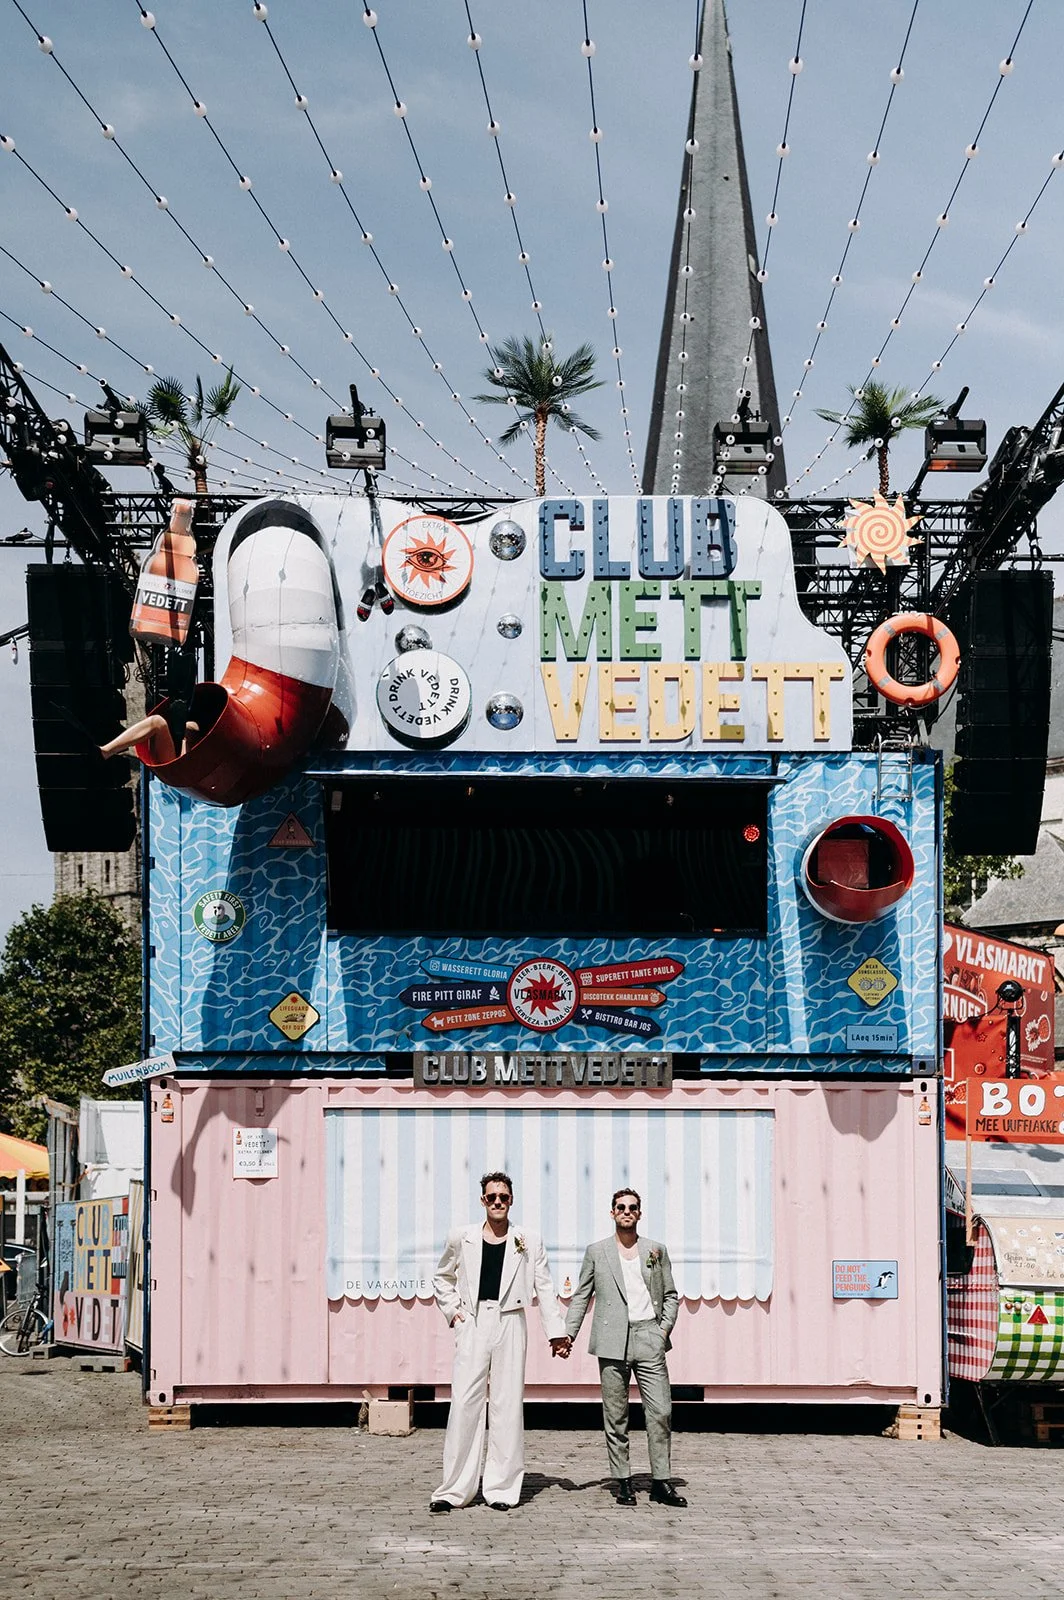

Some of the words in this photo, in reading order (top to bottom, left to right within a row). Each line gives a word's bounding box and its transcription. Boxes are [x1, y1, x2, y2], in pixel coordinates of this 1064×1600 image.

[422, 521, 446, 531] EXTRA
[539, 499, 737, 580] CLUB
[142, 591, 188, 612] VEDETT
[405, 587, 444, 600] TOEZICHT
[539, 580, 762, 661] METT
[388, 668, 415, 702] DRINK
[419, 669, 440, 711] VEDETT
[441, 678, 460, 715] DRINK
[540, 662, 845, 743] VEDETT
[392, 705, 441, 725] VEDETT
[198, 892, 222, 908] SAFETY
[223, 893, 241, 909] FIRST
[198, 922, 221, 938] VEDETT
[223, 925, 240, 938] AREA
[955, 935, 1046, 984] VLASMARKT
[442, 963, 482, 976] WASSERETT
[483, 968, 507, 979] GLORIA
[595, 970, 629, 983] SUPERETT
[631, 968, 652, 978] TANTE
[653, 965, 675, 975] PAULA
[412, 991, 432, 1002] FIRE
[434, 990, 453, 1001] PITT
[456, 989, 482, 1000] GIRAF
[514, 988, 573, 1001] VLASMARKT
[583, 993, 614, 1001] DISCOTEKK
[615, 993, 649, 1001] CHARLATAN
[446, 1015, 462, 1024] PETT
[464, 1013, 481, 1022] ZONE
[482, 1009, 507, 1020] ZEPPOS
[595, 1012, 622, 1025] BISTTRO
[624, 1018, 638, 1029] BAR
[639, 1022, 652, 1032] JOS
[422, 1055, 487, 1082] CLUB
[494, 1055, 568, 1082] METT
[571, 1055, 668, 1082] VEDETT
[975, 1117, 999, 1132] MEE
[77, 1203, 110, 1246] CLUB
[76, 1249, 111, 1291] METT
[835, 1264, 845, 1273] DO
[847, 1264, 861, 1273] NOT
[346, 1281, 361, 1289] DE
[367, 1280, 426, 1289] VAKANTIE
[835, 1274, 852, 1282] FEED
[854, 1274, 867, 1282] THE
[835, 1283, 871, 1291] PENGUINS
[75, 1296, 123, 1344] VEDET
